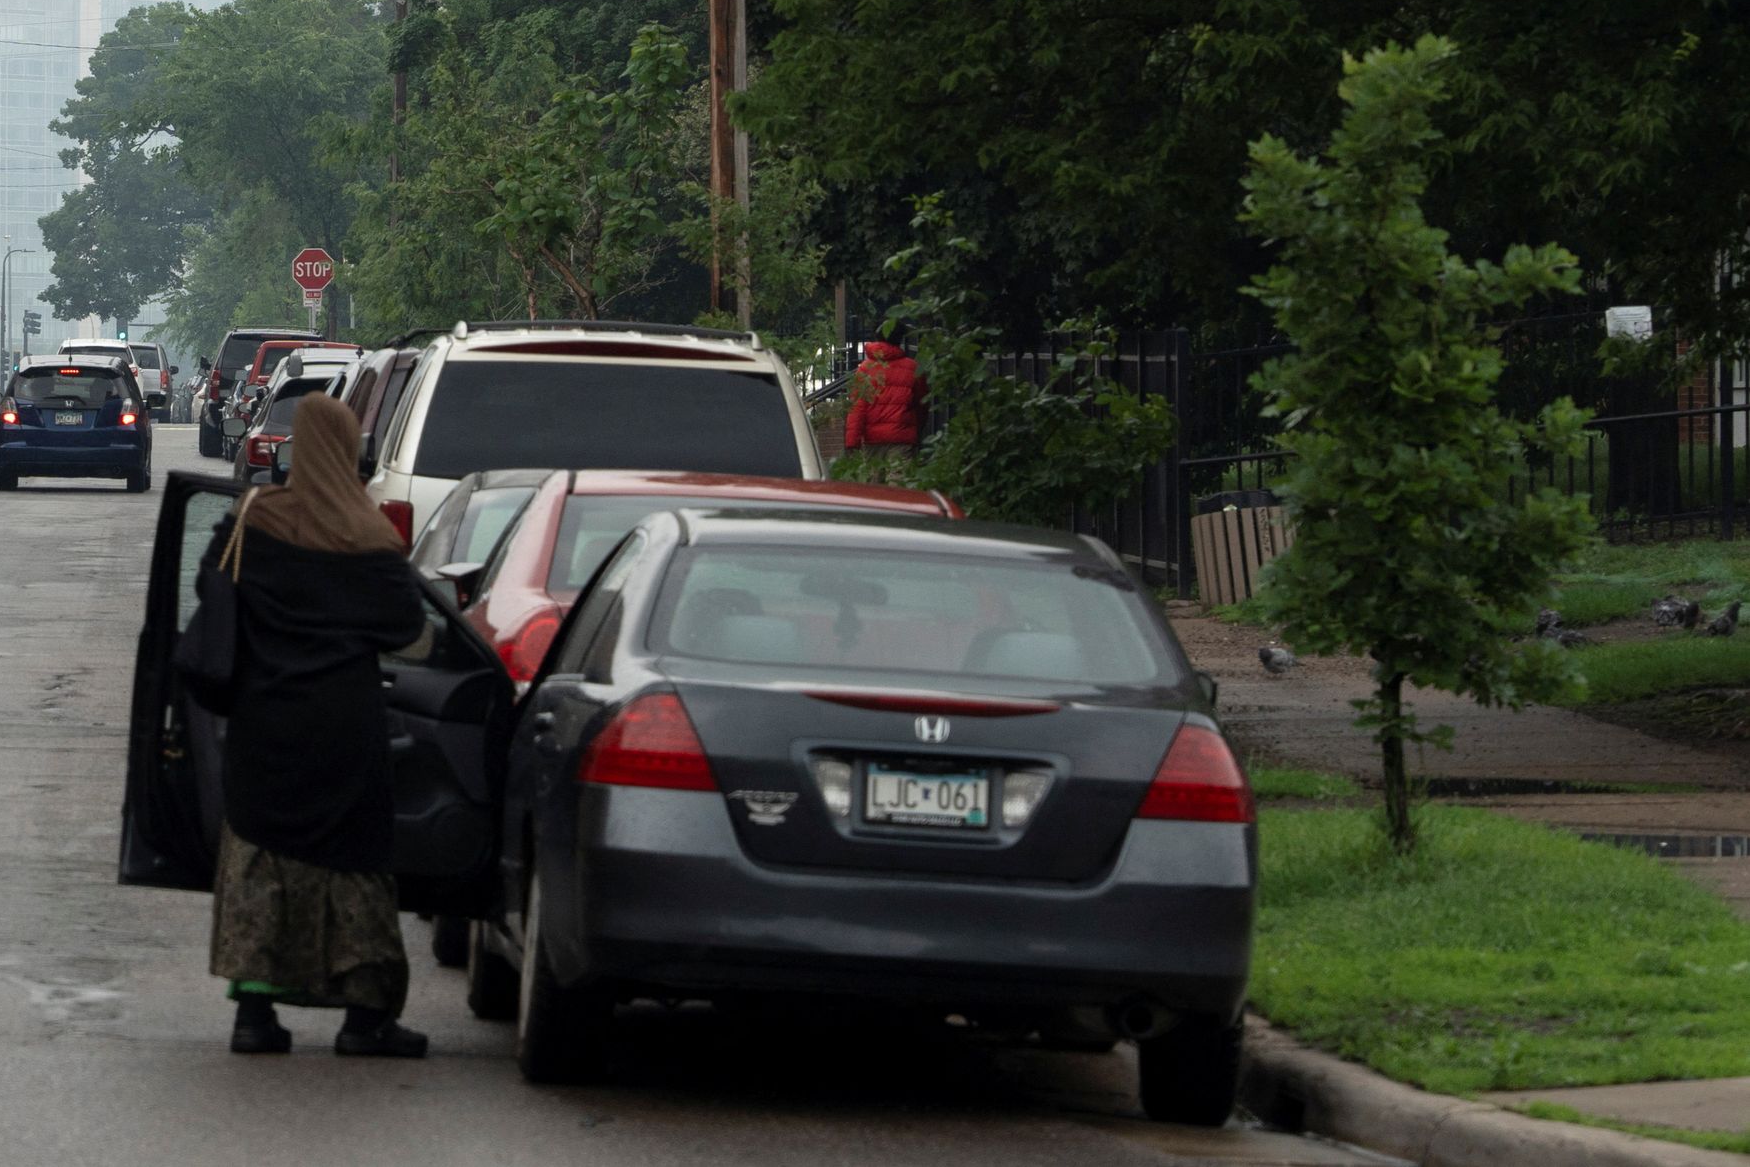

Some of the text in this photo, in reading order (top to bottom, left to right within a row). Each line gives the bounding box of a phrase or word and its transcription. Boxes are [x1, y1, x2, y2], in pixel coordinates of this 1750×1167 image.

[296, 262, 331, 277] STOP
[872, 777, 980, 811] LJC 061
